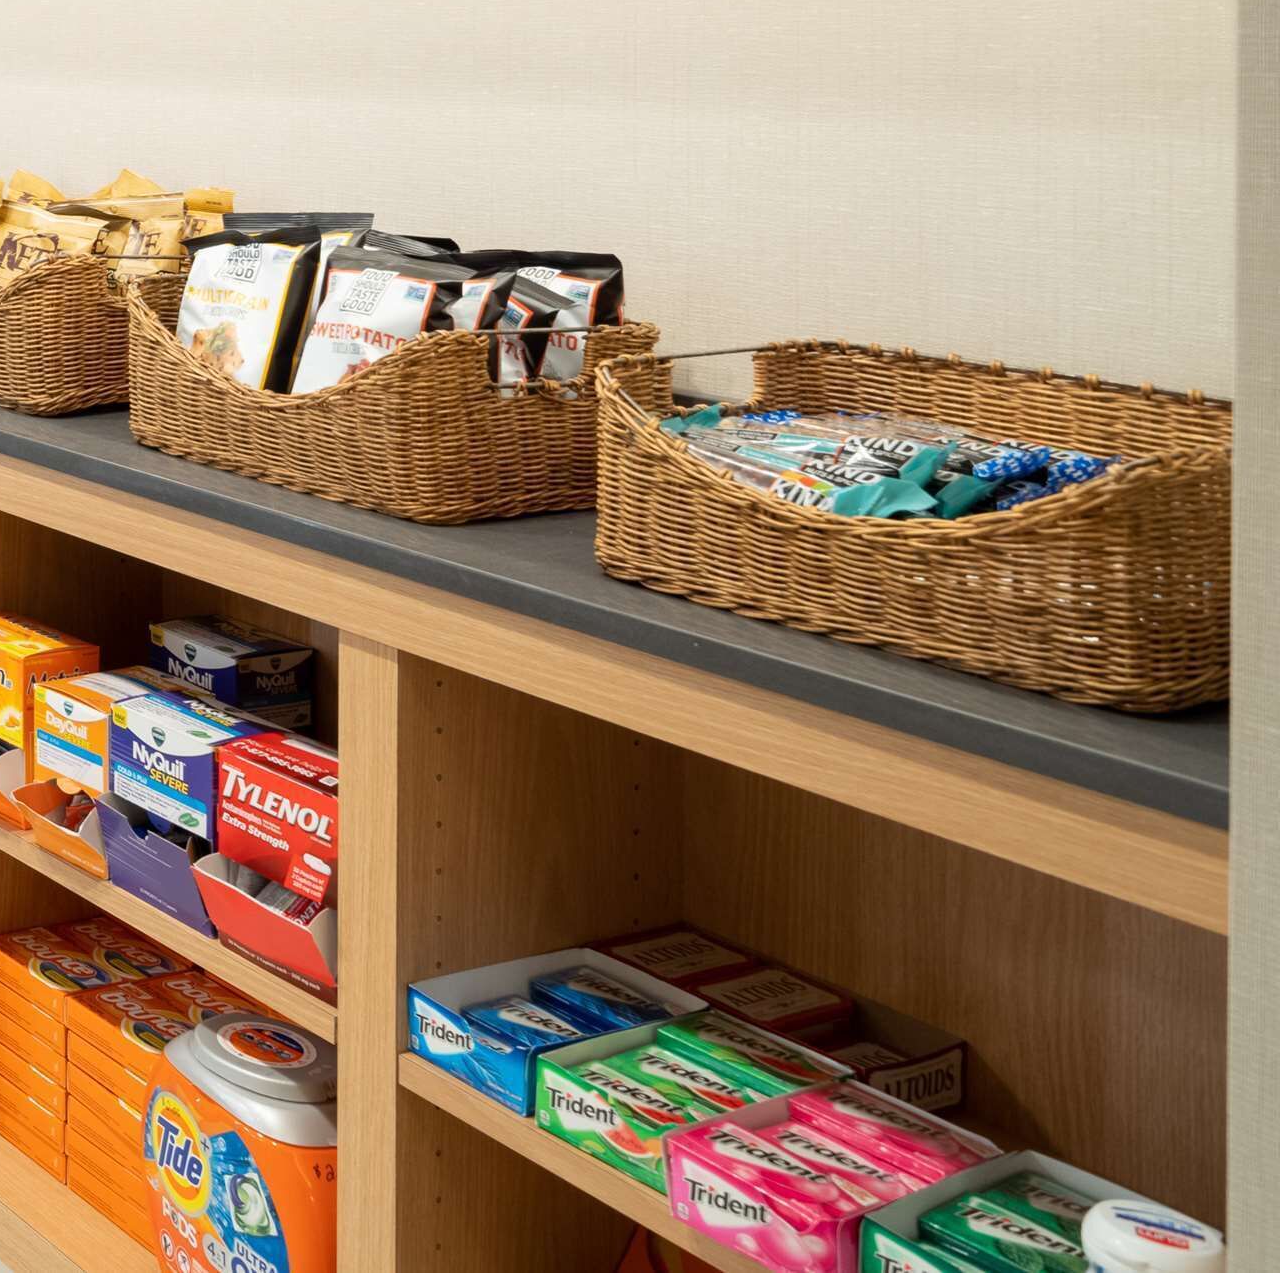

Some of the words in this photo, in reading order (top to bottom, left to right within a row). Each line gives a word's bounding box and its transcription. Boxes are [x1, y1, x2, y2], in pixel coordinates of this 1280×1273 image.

[228, 258, 259, 269] TASTE
[363, 269, 395, 282] FOOD
[519, 267, 555, 281] FOOD
[349, 289, 381, 303] TASTE
[354, 279, 387, 292] SHOULD
[342, 300, 374, 314] GOOD
[843, 433, 920, 457] KIND
[807, 457, 881, 485] KIND
[168, 657, 215, 691] NyQuil
[256, 671, 295, 692] NyQuil
[46, 712, 89, 740] DayQuil
[133, 741, 187, 781] NyQuil
[150, 768, 189, 795] SEVERE
[221, 764, 333, 842] TYLENOL
[222, 812, 247, 831] Extra
[247, 822, 290, 852] Strength
[11, 932, 97, 978] bounce
[74, 923, 162, 966] bounce
[640, 940, 715, 967] ALTOIDS
[724, 978, 807, 1010] ALTOIDS
[416, 1013, 473, 1051] Trident
[699, 1022, 801, 1060] Trident
[581, 1068, 683, 1115] Trident
[637, 1053, 742, 1097] Trident
[546, 1085, 617, 1127] Trident
[830, 1092, 943, 1137] Trident
[155, 1114, 204, 1188] Tide
[708, 1130, 830, 1184] Trident
[777, 1130, 891, 1182] Trident
[684, 1176, 769, 1225] Trident
[161, 1195, 198, 1248] PODS
